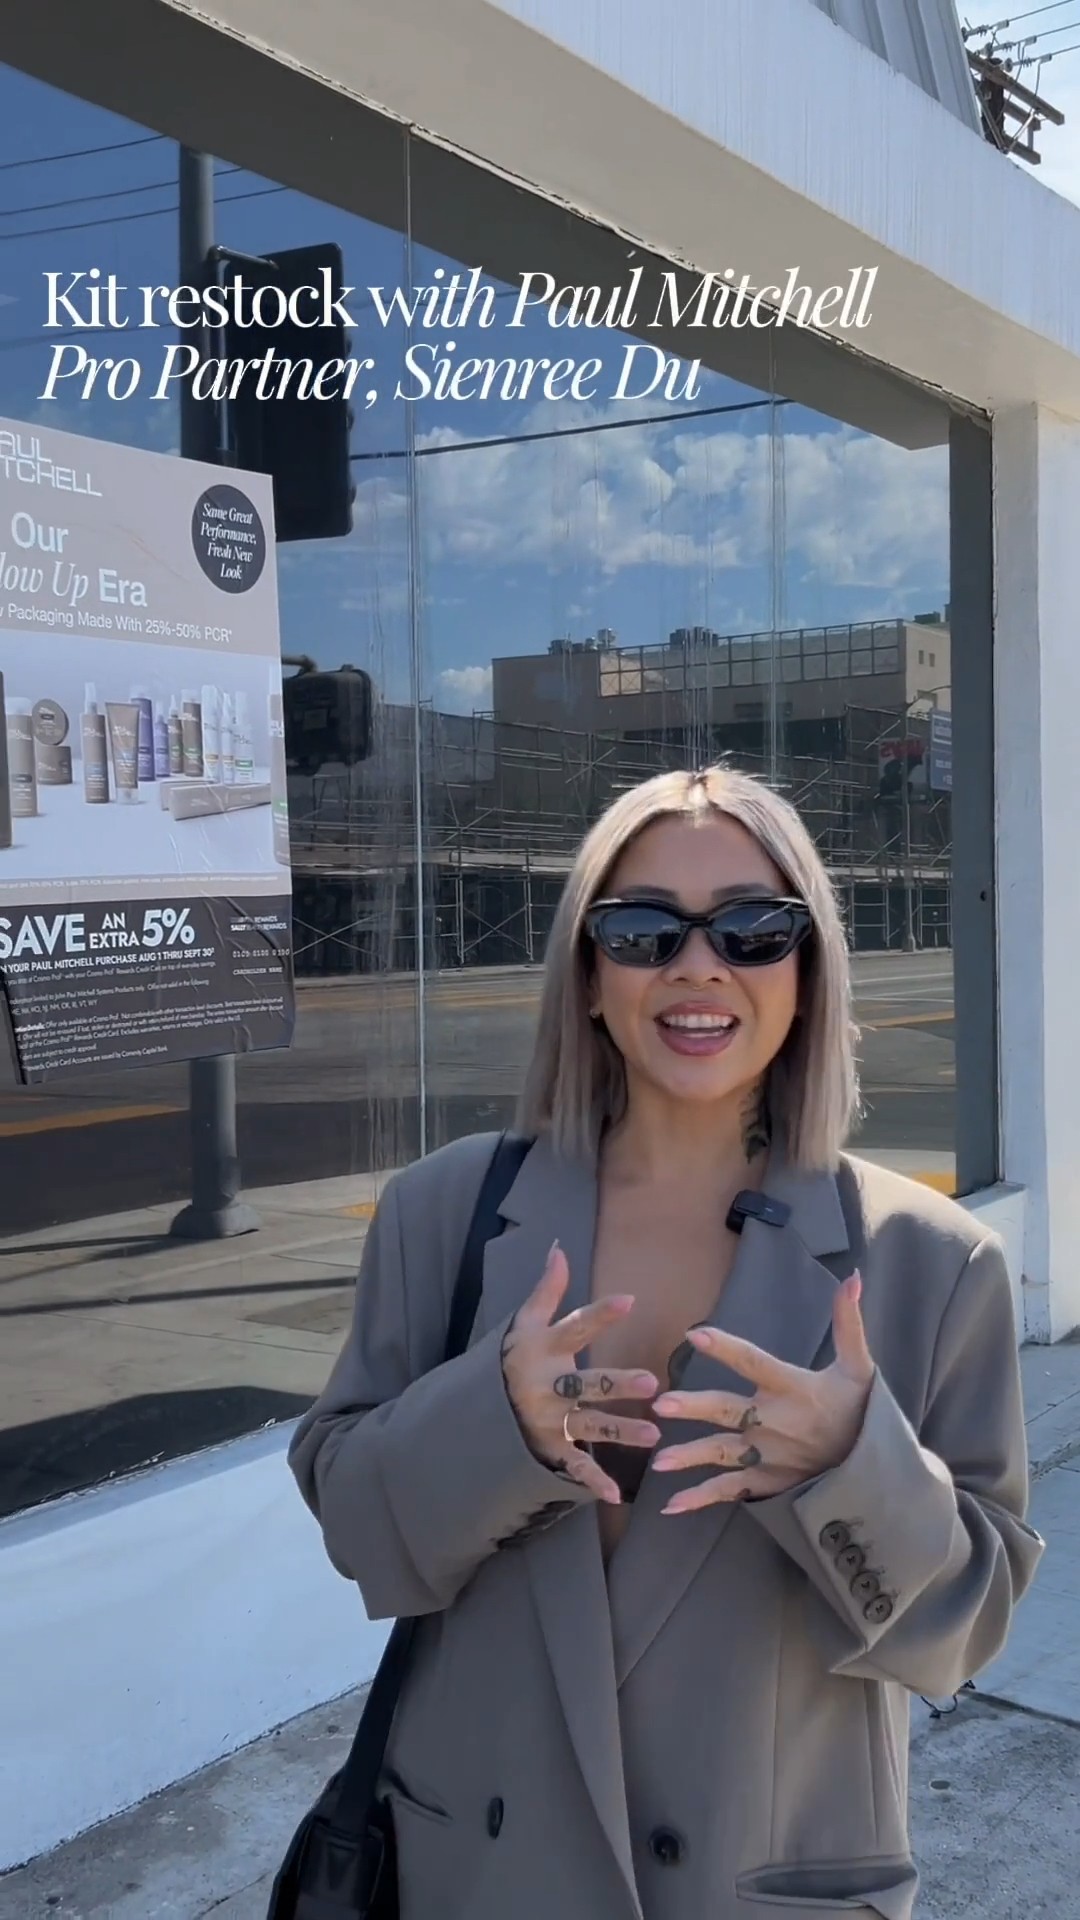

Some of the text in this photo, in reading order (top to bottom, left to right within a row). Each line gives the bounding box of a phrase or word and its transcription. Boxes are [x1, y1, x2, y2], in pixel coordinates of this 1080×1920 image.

[202, 503, 253, 525] Same Great
[11, 511, 69, 554] Our
[207, 542, 254, 563] Fresh New
[52, 560, 89, 607] Up
[98, 568, 148, 608] Era
[220, 563, 242, 580] Look
[8, 603, 74, 628] Packaging
[77, 611, 112, 629] Made
[114, 614, 142, 633] With
[145, 619, 202, 640] 25%-50%
[0, 907, 195, 959] SAVE AN EXTRA 5%
[8, 962, 30, 974] YOUR
[31, 960, 53, 971] PAUL
[54, 957, 94, 969] MITCHELL
[95, 953, 137, 966] PURCHASE
[138, 952, 156, 963] AUG
[162, 949, 183, 961] THRU
[184, 948, 202, 959] SEPT
